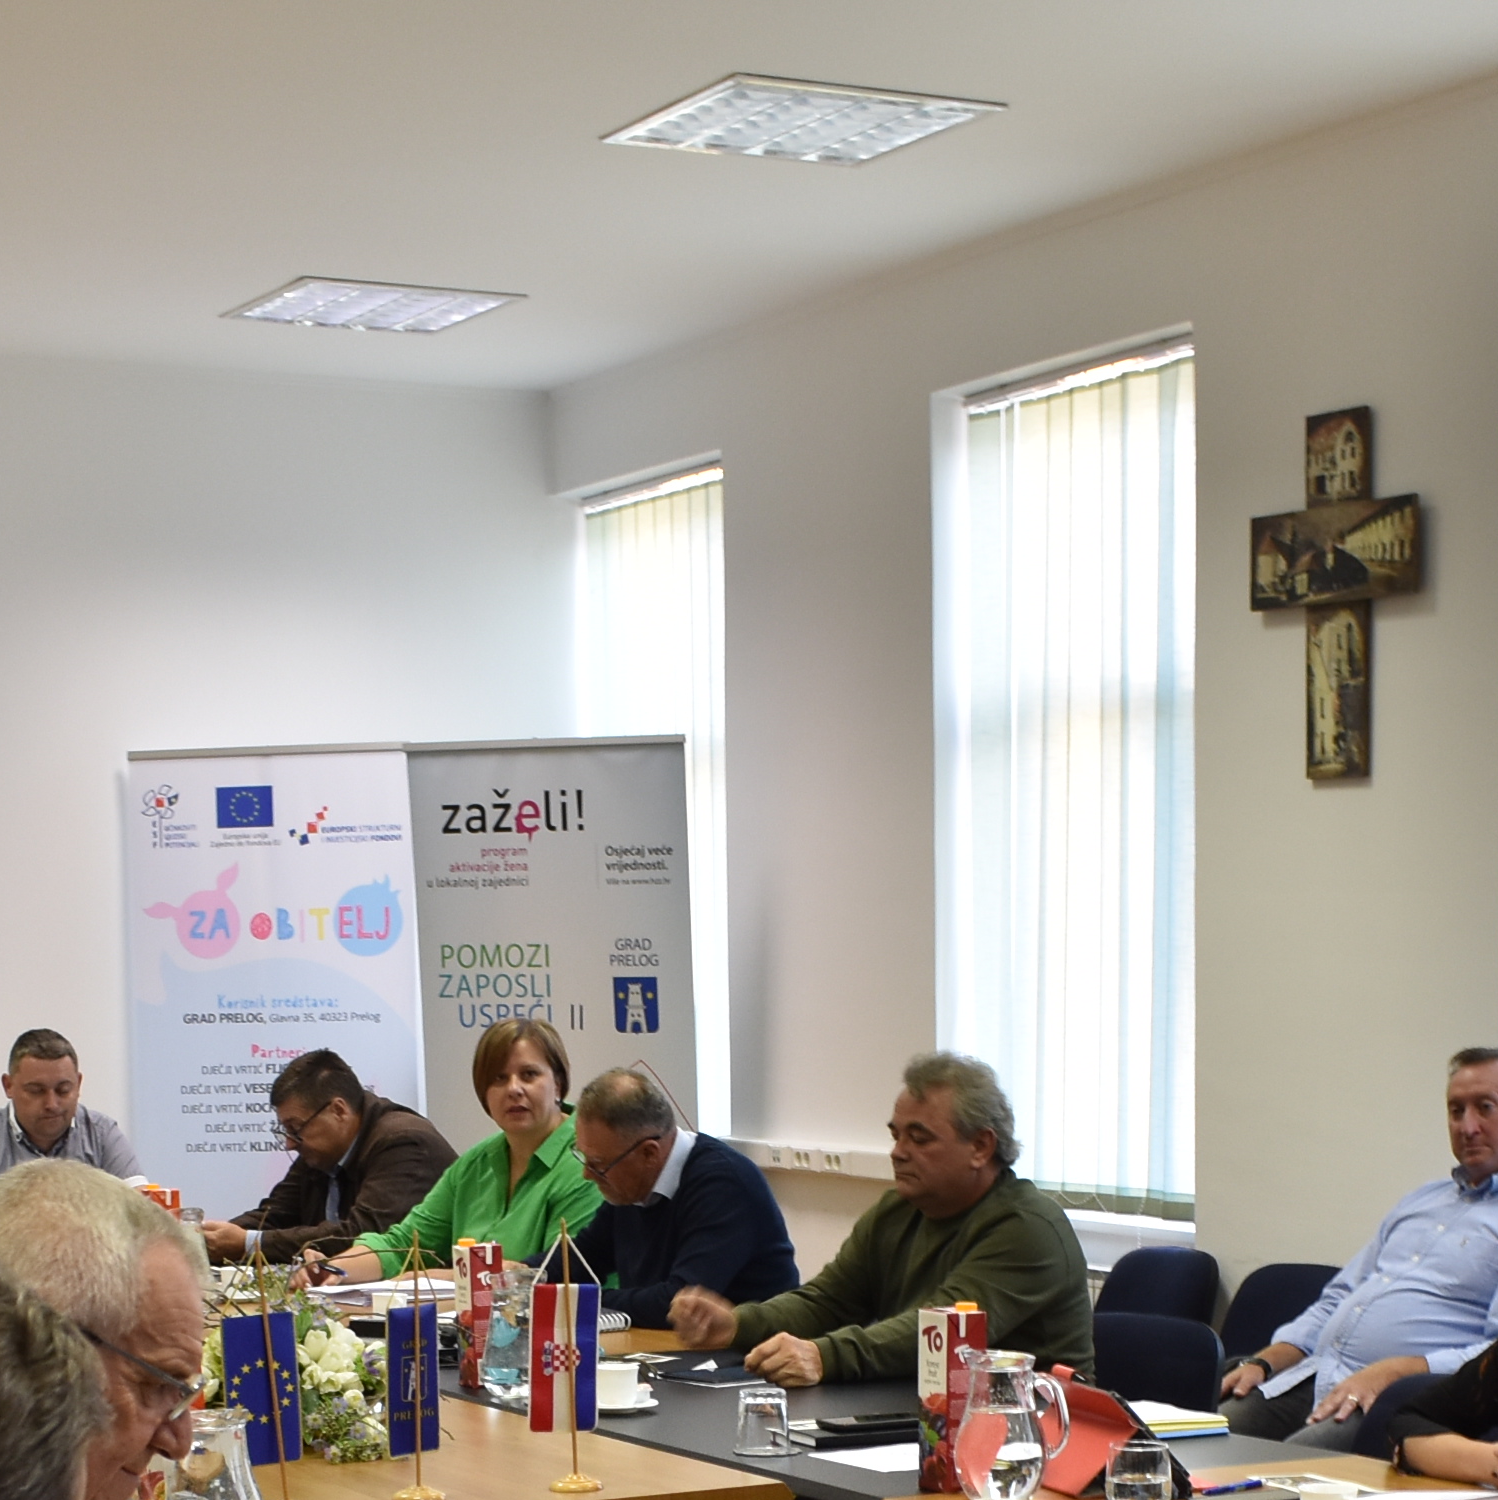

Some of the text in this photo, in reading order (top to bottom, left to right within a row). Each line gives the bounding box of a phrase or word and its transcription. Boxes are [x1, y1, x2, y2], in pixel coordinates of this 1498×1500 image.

[441, 788, 585, 841] zaželi!
[480, 847, 528, 859] program
[449, 862, 500, 874] aktivacije
[426, 876, 529, 889] u lokalnoj zajednici
[189, 904, 391, 943] ZA OBITELJ
[614, 938, 652, 951] GRAD
[441, 943, 550, 969] POMOZI
[609, 954, 660, 967] PRELOG
[438, 973, 551, 999] ZAPOSLI
[183, 1012, 216, 1025] GRAD
[351, 1012, 381, 1024] Prelog
[570, 1004, 584, 1030] II
